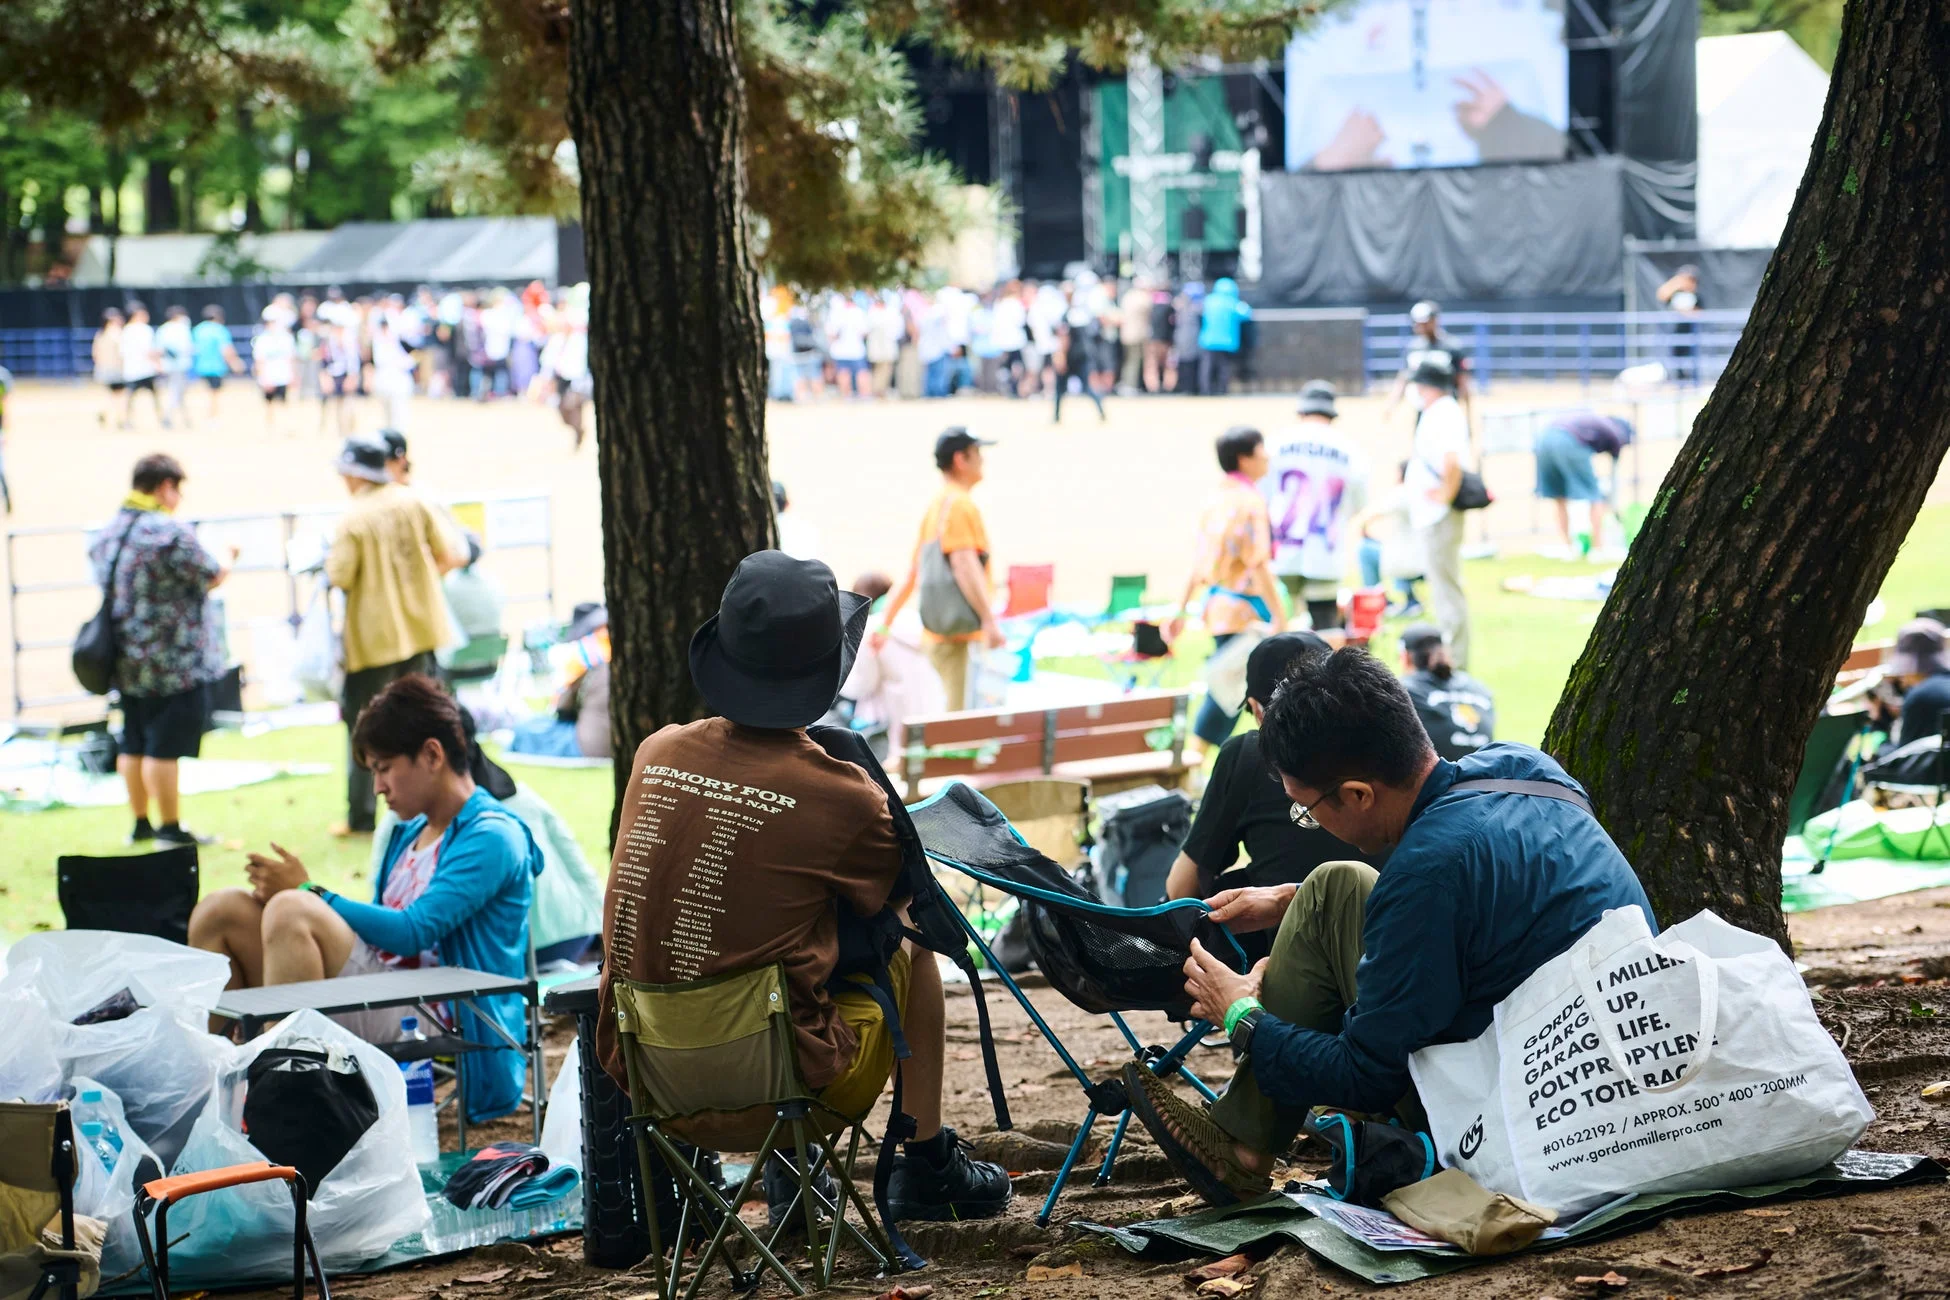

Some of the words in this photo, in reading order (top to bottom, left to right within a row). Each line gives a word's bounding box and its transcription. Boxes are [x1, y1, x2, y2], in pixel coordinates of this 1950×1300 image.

[642, 765, 739, 792] MEMORY
[740, 786, 797, 809] FOR
[642, 777, 662, 785] SEP
[663, 780, 700, 796] 21-22,
[703, 790, 743, 804] 2024
[745, 800, 782, 816] NAF
[662, 796, 678, 804] SAT
[705, 815, 736, 824] TEMPEST
[736, 822, 760, 832] STAGE
[721, 809, 741, 818] SEP
[742, 815, 764, 826] SUN
[646, 836, 667, 845] ROCKETS
[701, 843, 723, 853] SHOUTA
[723, 849, 735, 857] AOI
[705, 852, 723, 861] angela
[694, 858, 710, 867] SPIRA
[710, 862, 728, 871] SPICA
[688, 872, 701, 880] MIYU
[702, 876, 723, 886] TOMITA
[695, 882, 711, 890] FLOW
[681, 887, 696, 895] RAISE
[672, 929, 689, 937] OMEGA
[690, 932, 712, 942] SISTERS
[1523, 1012, 1595, 1066] CHARG
[1606, 991, 1645, 1014] UP,
[1524, 1032, 1600, 1085] GARAG
[1617, 1012, 1671, 1042] LIFE.
[1528, 1030, 1719, 1109] POLYPRPYLEN
[1535, 1098, 1577, 1130] ECO
[1580, 1077, 1640, 1107] TOTE
[1542, 1122, 1616, 1157] #01622192
[1622, 1116, 1628, 1134] /
[1633, 1102, 1691, 1129] APPROX.
[1548, 1116, 1723, 1173] www.gordonmillerpro.com
